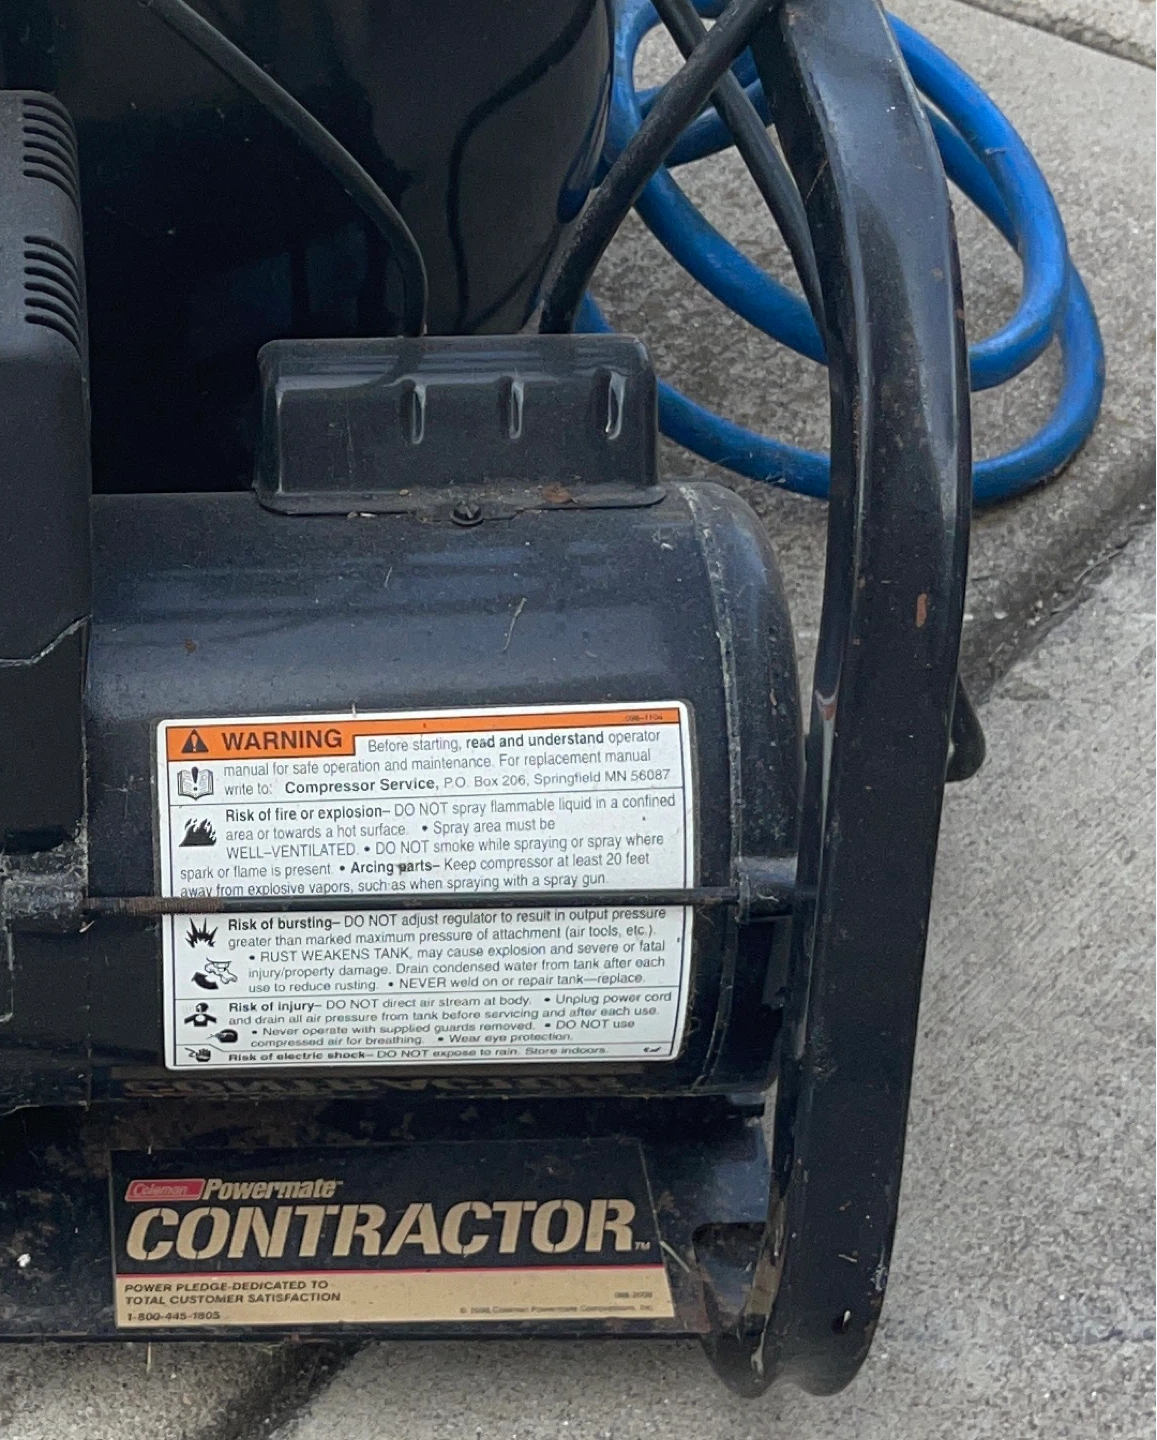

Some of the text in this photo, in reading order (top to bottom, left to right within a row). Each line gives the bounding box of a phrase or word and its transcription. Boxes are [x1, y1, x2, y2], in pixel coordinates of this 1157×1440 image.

[222, 729, 342, 751] WARNING
[368, 730, 660, 752] Before starting, read and understand operator
[224, 762, 268, 776] manual
[272, 762, 288, 775] for
[292, 760, 318, 774] safe
[322, 759, 379, 776] operation
[384, 757, 407, 771] and
[499, 753, 519, 767] For
[524, 750, 601, 768] replacement
[605, 749, 650, 762] manual
[224, 783, 253, 795] write
[285, 781, 375, 795] Compressor
[380, 777, 438, 791] Service,
[474, 776, 498, 787] Box
[534, 771, 600, 786] Springfield
[605, 770, 626, 781] MN
[630, 768, 670, 781] 56087
[226, 808, 254, 822] Risk
[258, 807, 270, 821] of
[274, 807, 296, 820] fire
[300, 809, 314, 820] or
[394, 802, 414, 816] DO
[419, 801, 448, 815] NOT
[452, 803, 486, 817] spray
[490, 798, 554, 812] flammable
[559, 796, 591, 813] liquid
[596, 798, 605, 808] in
[610, 798, 617, 808] a
[622, 793, 675, 808] confined
[376, 841, 395, 854] DO
[400, 840, 429, 854] NOT
[433, 839, 474, 853] smoke
[478, 838, 510, 851] while
[514, 838, 566, 853] spraying
[571, 837, 583, 848] or
[588, 836, 621, 850] spray
[625, 833, 663, 846] where
[228, 919, 256, 930] Risk
[260, 918, 273, 930] of
[344, 916, 364, 927] DO
[368, 915, 396, 926] NOT
[402, 914, 438, 928] adjust
[442, 913, 497, 927] regulator
[500, 912, 512, 922] to
[554, 912, 565, 920] in
[569, 910, 608, 923] output
[612, 908, 666, 922] pressure
[260, 950, 297, 962] RUST
[301, 948, 369, 961] WEAKENS
[417, 948, 442, 960] may
[446, 947, 483, 957] cause
[488, 944, 545, 958] explosion
[550, 942, 573, 954] and
[577, 944, 618, 954] severe
[622, 943, 635, 952] or
[639, 940, 664, 952] fatal
[133, 1179, 335, 1200] Coleman Powermate
[126, 1198, 635, 1260] CONTRACTOR
[125, 1284, 171, 1292] POWER
[311, 1280, 328, 1289] TO
[126, 1292, 340, 1305] TOTAL CUSTOMER SATISFACTION
